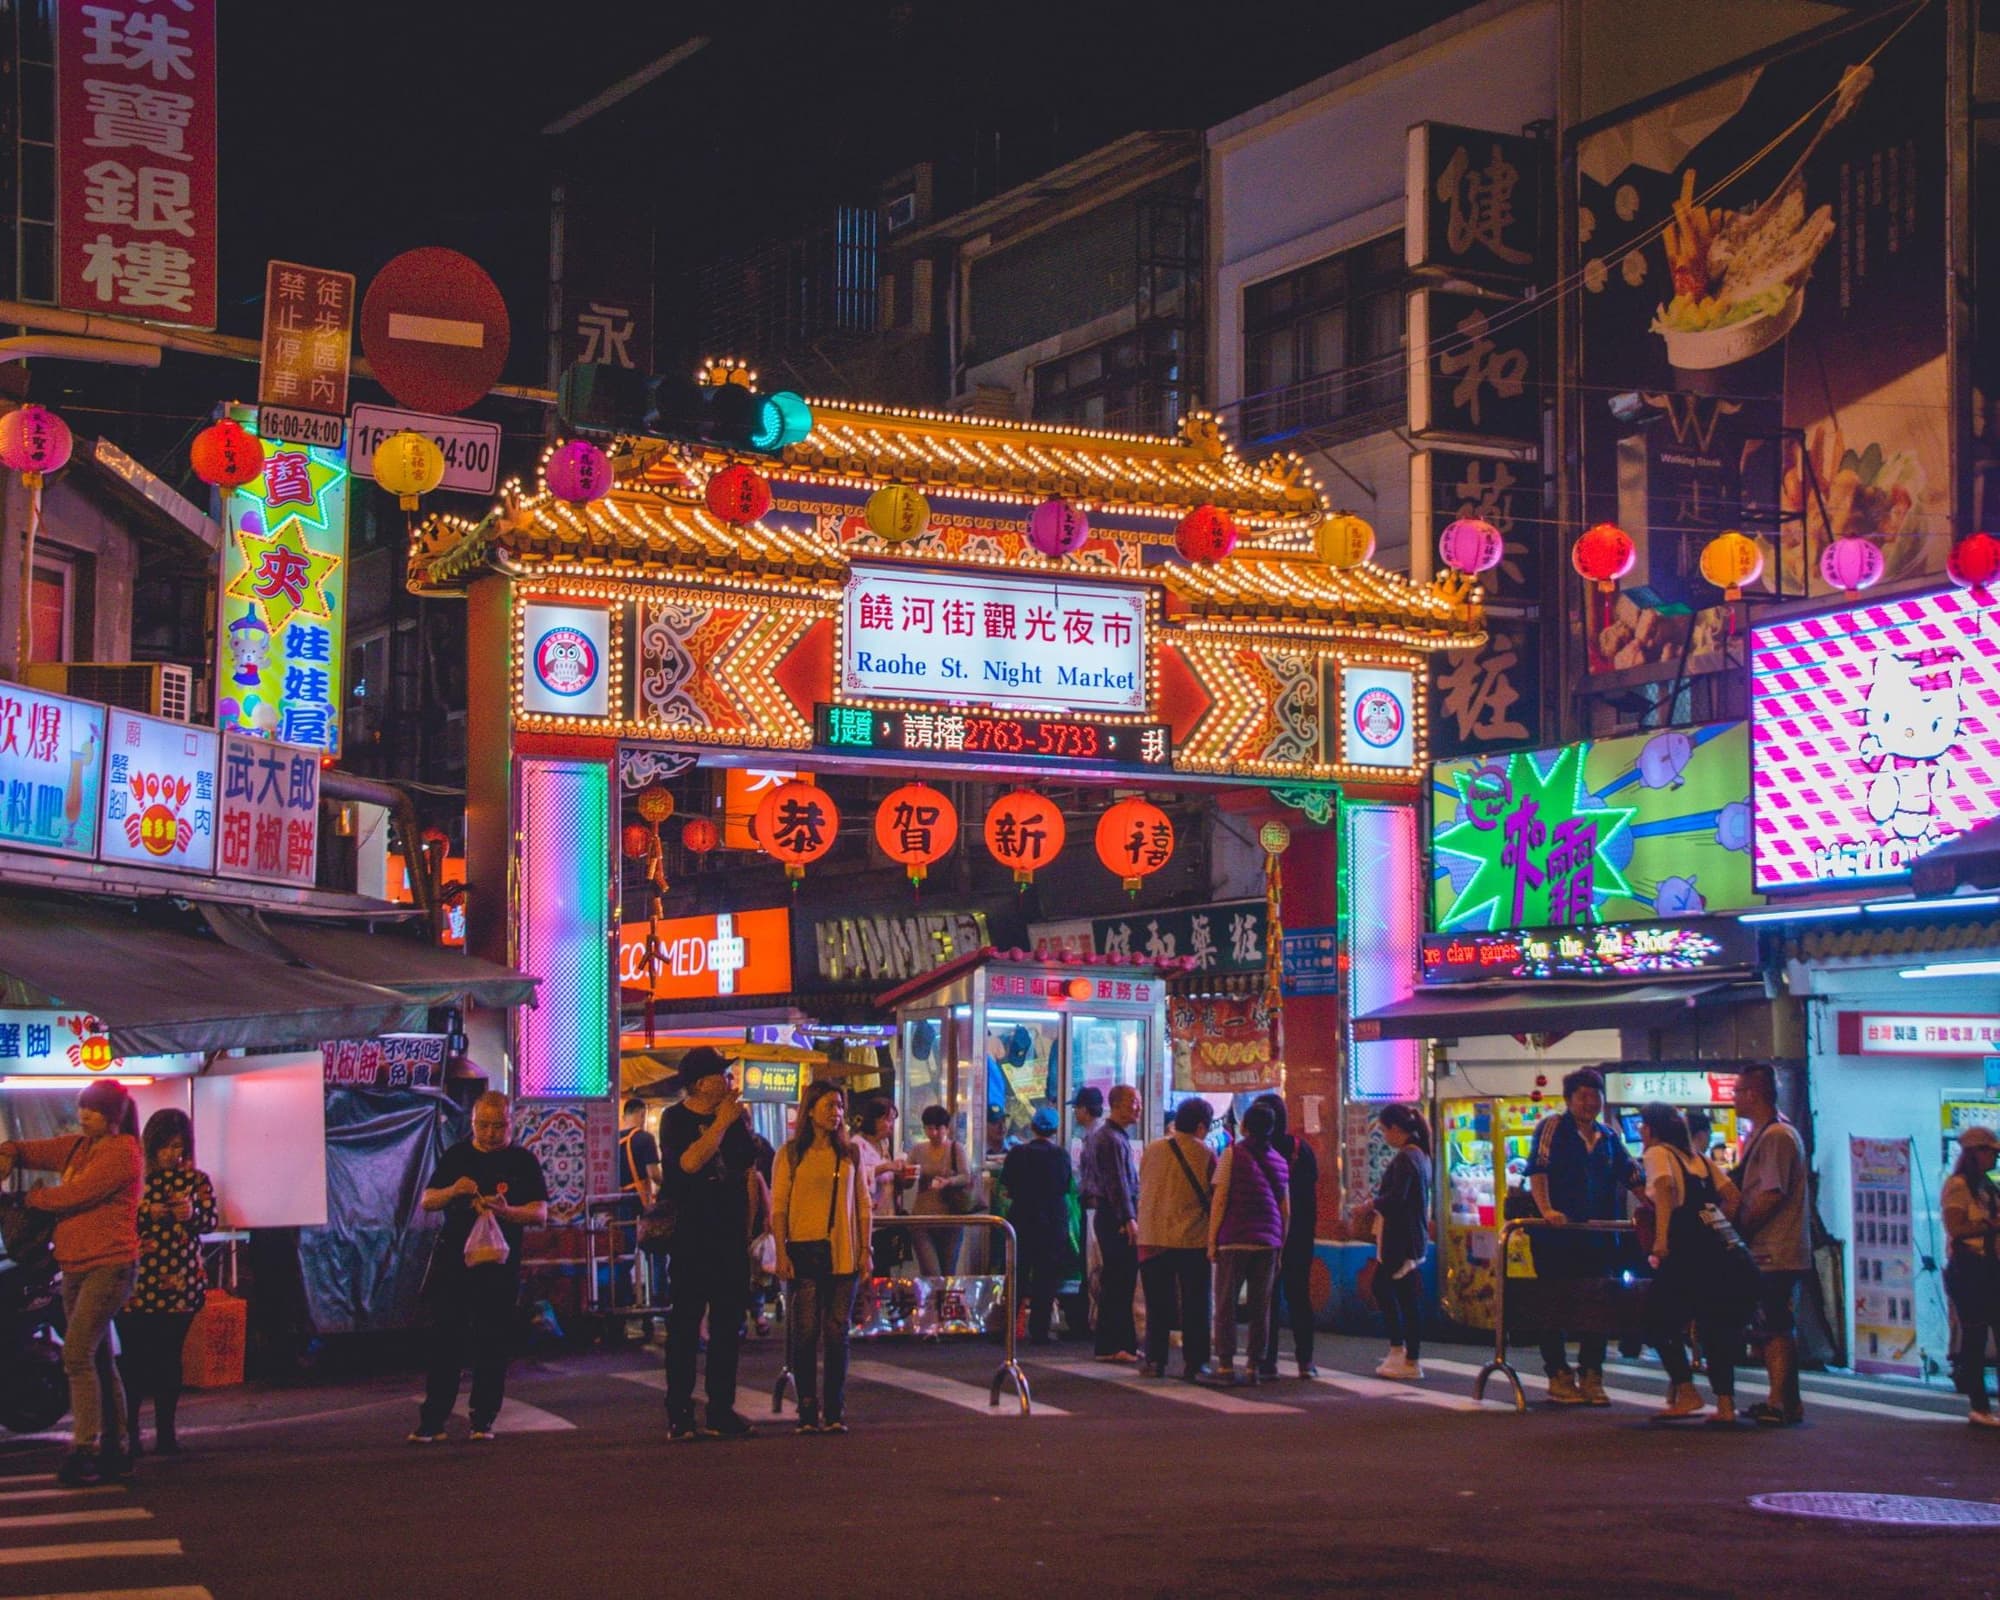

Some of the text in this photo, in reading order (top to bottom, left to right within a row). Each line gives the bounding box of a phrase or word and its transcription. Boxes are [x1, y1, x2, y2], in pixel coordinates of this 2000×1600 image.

[81, 0, 195, 312] 珠寶銀樓
[271, 271, 305, 398] 禁止停車
[310, 276, 344, 405] 徒步區內
[262, 411, 339, 445] 16:00-24:00
[358, 425, 490, 472] 1624:00
[859, 591, 1133, 648] 饒河街觀光夜市
[279, 623, 331, 747] 娃娃屋
[857, 651, 1135, 690] Raohe St. Night Market
[224, 742, 317, 813] 武大郎
[0, 779, 64, 840] 料吧
[773, 799, 826, 852] 恭
[894, 801, 940, 854] 賀
[994, 812, 1047, 858] 新
[222, 808, 314, 878] 胡椒餅
[1479, 940, 1518, 966] games
[385, 1040, 440, 1061] 不好吃
